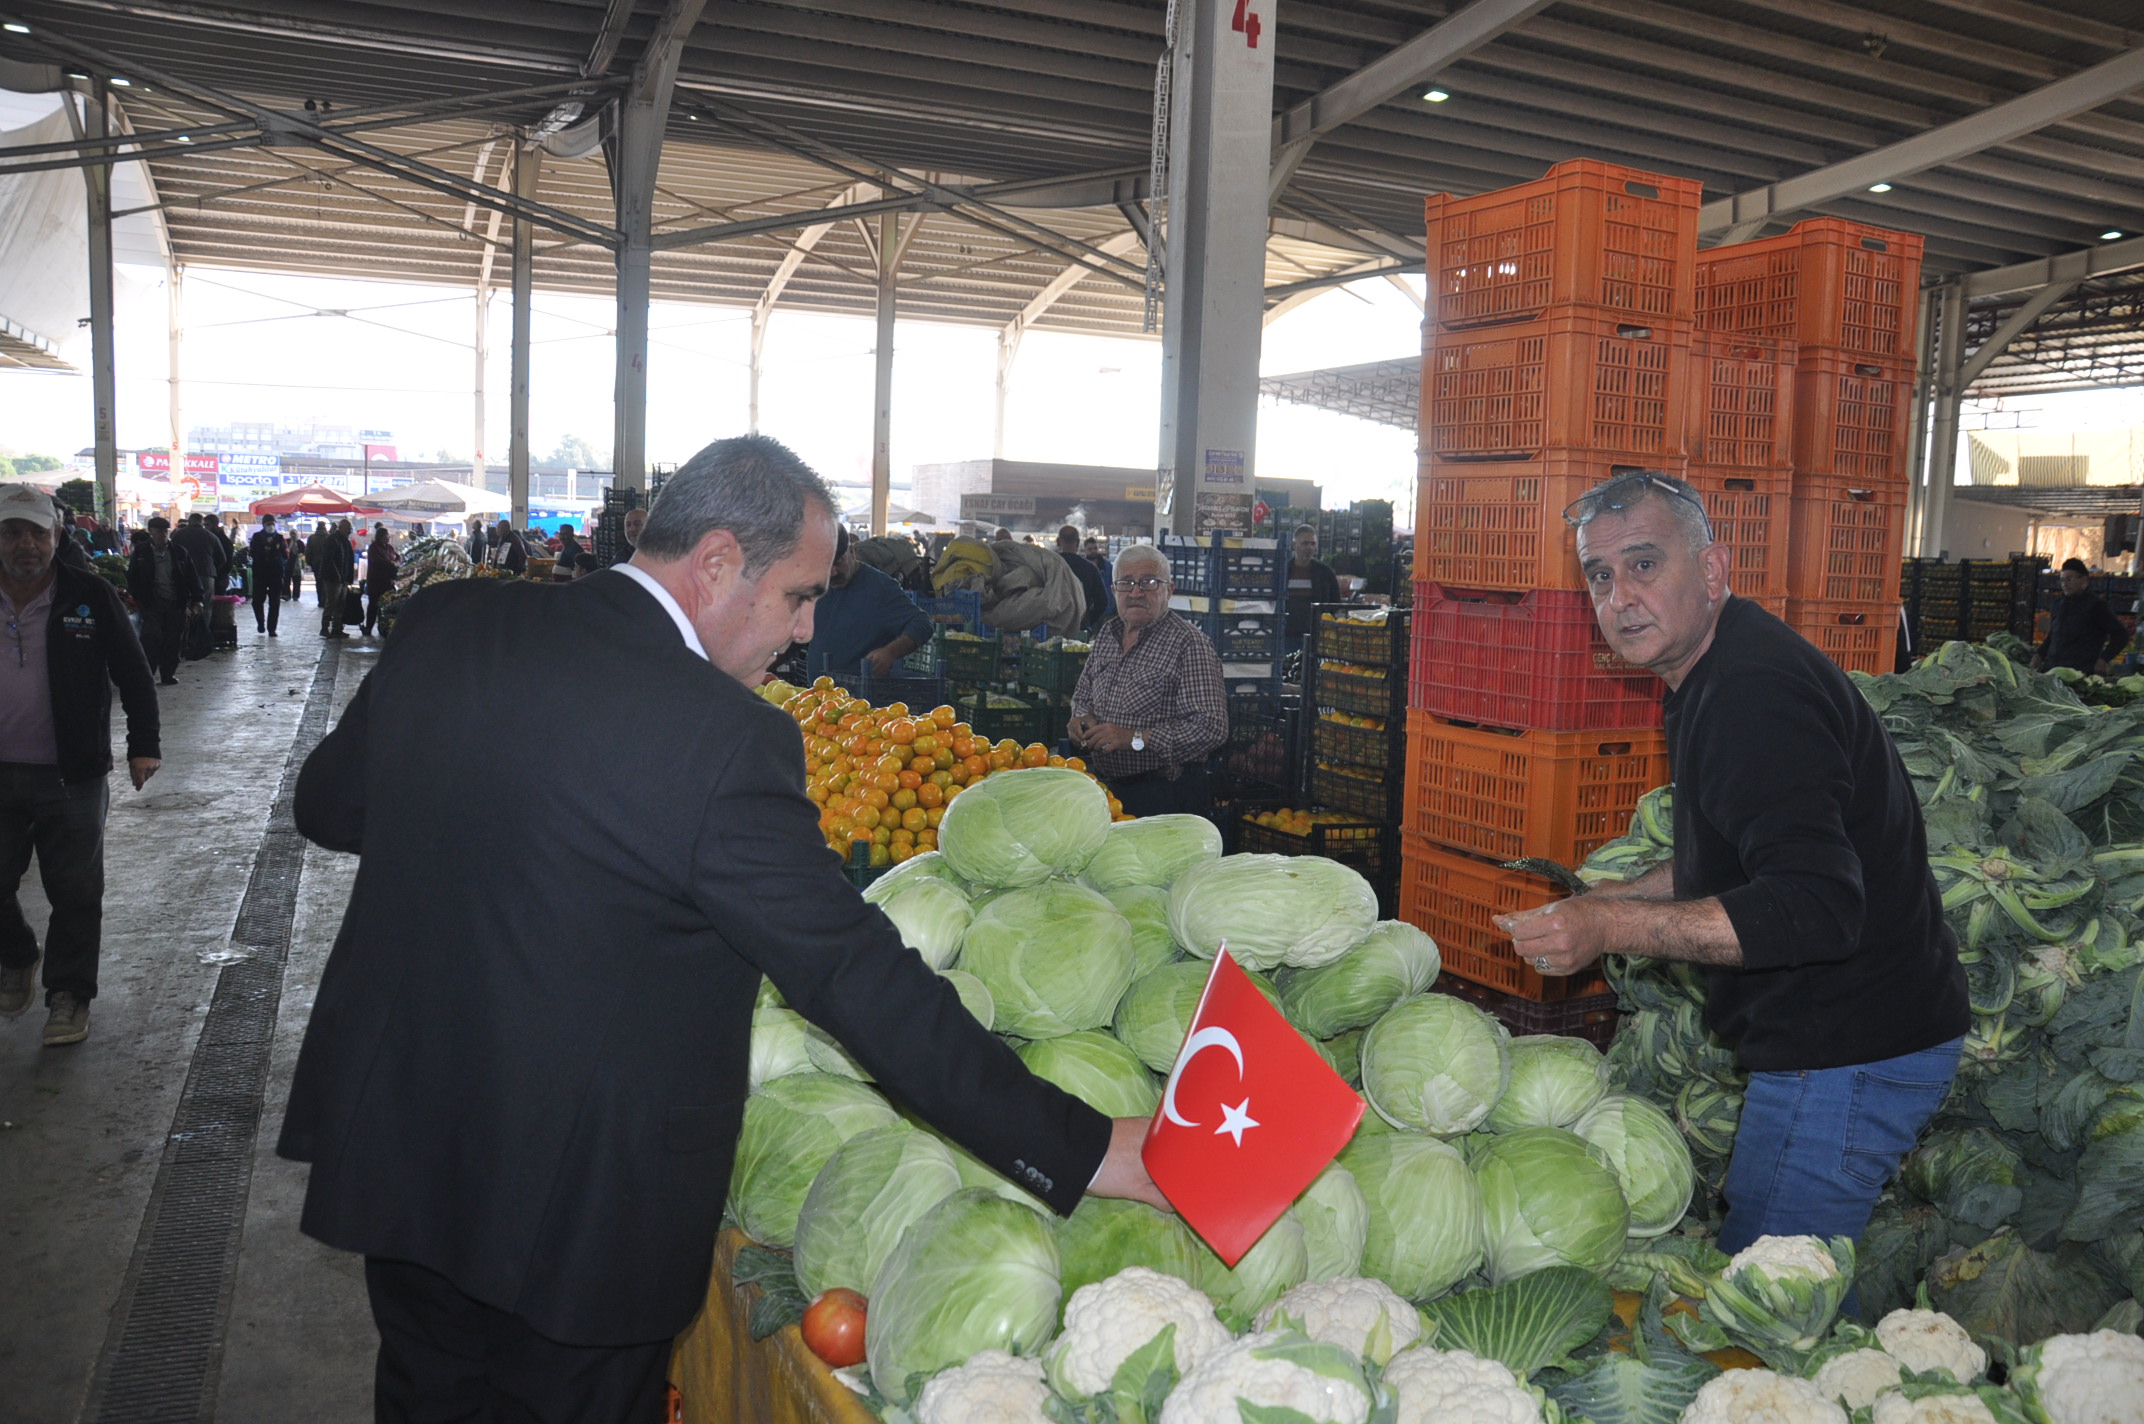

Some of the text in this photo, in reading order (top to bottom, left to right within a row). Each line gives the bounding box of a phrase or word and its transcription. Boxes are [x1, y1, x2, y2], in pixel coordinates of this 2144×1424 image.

[155, 456, 216, 469] PAKKALE
[232, 454, 277, 465] METRO
[964, 498, 988, 508] ESNAF
